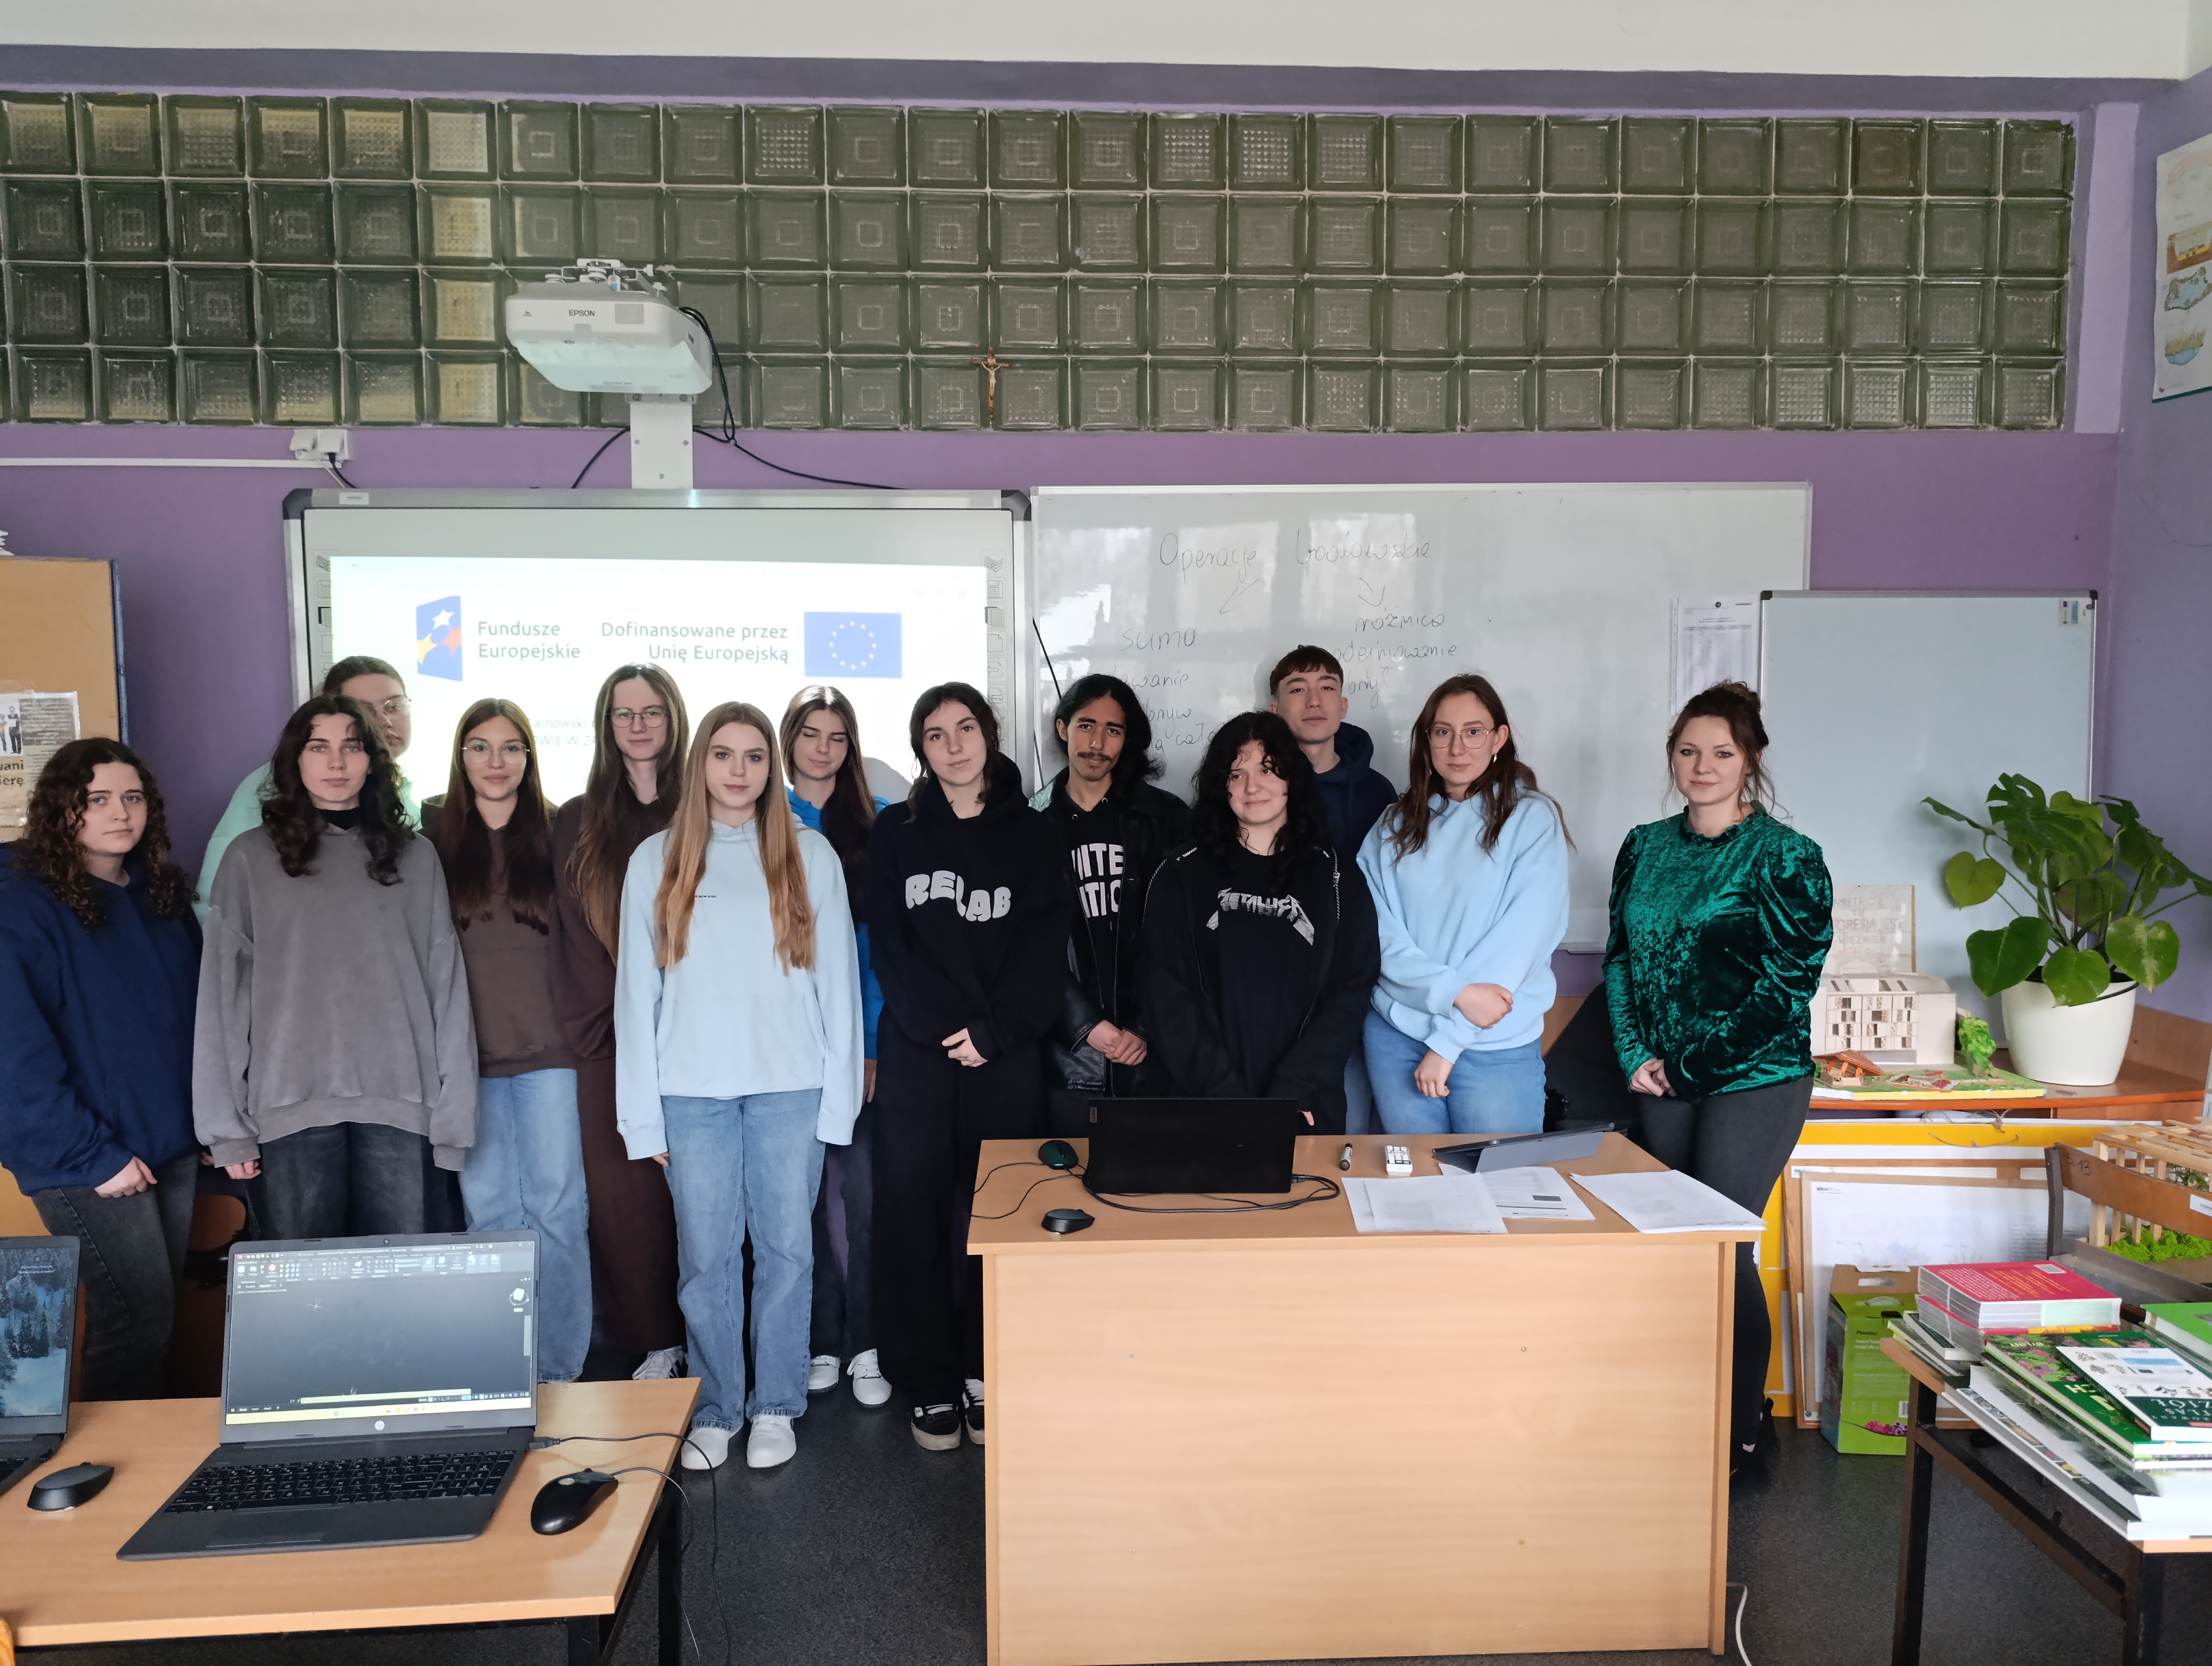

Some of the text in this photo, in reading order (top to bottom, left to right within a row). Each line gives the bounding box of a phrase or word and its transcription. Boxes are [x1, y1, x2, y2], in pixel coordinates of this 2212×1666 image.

[1160, 533, 1257, 584] Operacje
[478, 621, 561, 636] Fundusze
[601, 621, 788, 641] Dofinansowane przez
[1121, 629, 1197, 651] suma
[478, 643, 581, 660] Europejskie
[649, 645, 789, 664] Unię Europejską
[529, 717, 587, 728] arnowski
[905, 870, 1011, 921] RELAB
[1206, 887, 1315, 946] METALLICA
